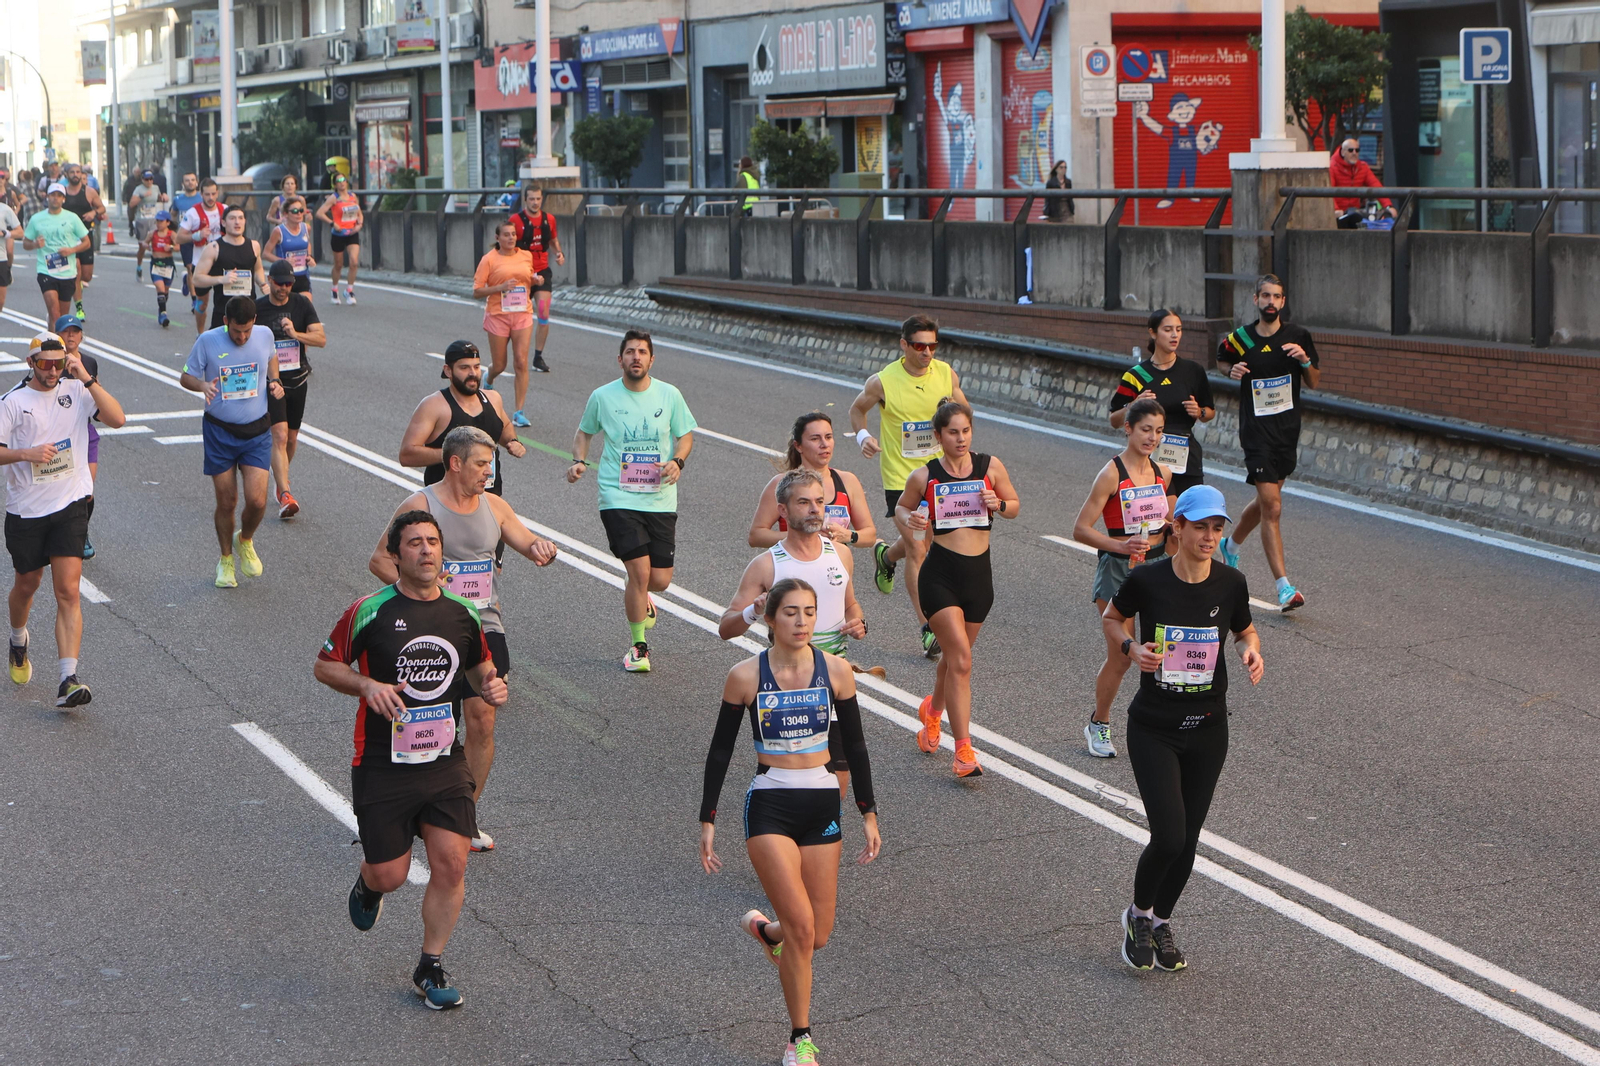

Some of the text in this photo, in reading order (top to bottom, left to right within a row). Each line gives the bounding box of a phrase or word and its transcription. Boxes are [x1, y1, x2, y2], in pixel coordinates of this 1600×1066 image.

[1216, 47, 1248, 64] Maña
[1472, 36, 1509, 79] P ARJONA
[1172, 74, 1231, 86] RECAMBIOS
[234, 366, 255, 374] ZURICH
[1266, 378, 1287, 387] ZURICH
[1166, 437, 1187, 445] ZURICH
[40, 463, 69, 475] SALGADINHO
[952, 484, 980, 492] ZURICH
[1136, 488, 1159, 497] ZURICH
[953, 500, 970, 508] 7406
[1139, 503, 1154, 512] 8385
[943, 510, 962, 518] JOANA
[1132, 512, 1162, 523] RITA MESTRE
[462, 563, 488, 572] ZURICH
[463, 580, 479, 589] 7775
[460, 591, 480, 599] CLERIO
[1188, 632, 1219, 641] ZURICH
[1186, 650, 1207, 660] 8349
[395, 654, 449, 668] Donando
[1186, 662, 1206, 670] GABO
[396, 665, 447, 683] Vidas
[782, 693, 820, 705] ZURICH
[415, 709, 446, 720] ZURICH
[781, 714, 809, 726] 13049
[415, 729, 435, 739] 8626
[779, 728, 814, 738] VANESSA
[410, 740, 439, 751] MANOLO
